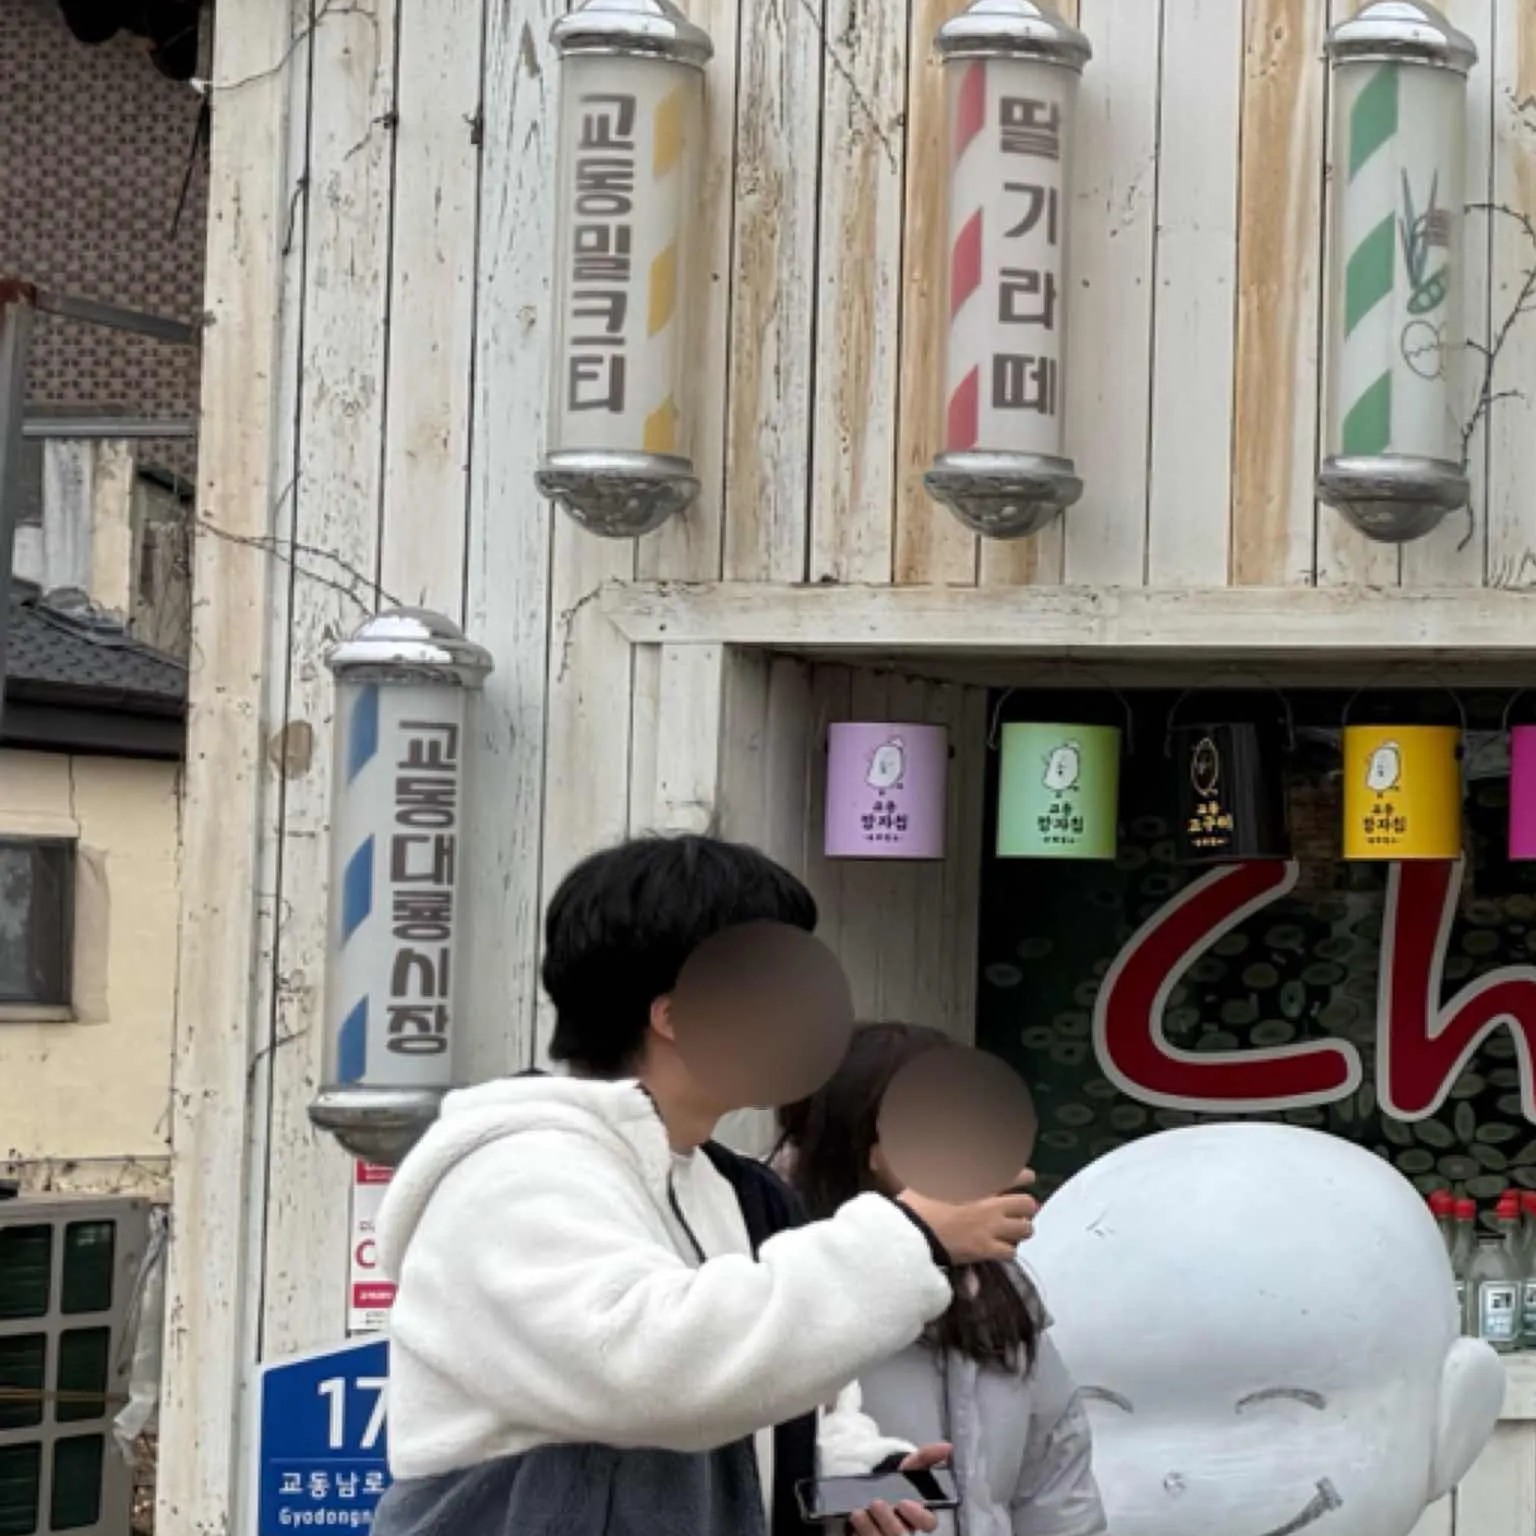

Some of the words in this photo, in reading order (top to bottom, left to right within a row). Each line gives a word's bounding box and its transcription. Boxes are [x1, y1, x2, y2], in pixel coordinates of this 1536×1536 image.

[569, 93, 638, 415] 교동밀크티
[991, 95, 1061, 417] 딸기라떼
[387, 720, 458, 1056] 교동대룡시장
[278, 1471, 385, 1498] 교동남로
